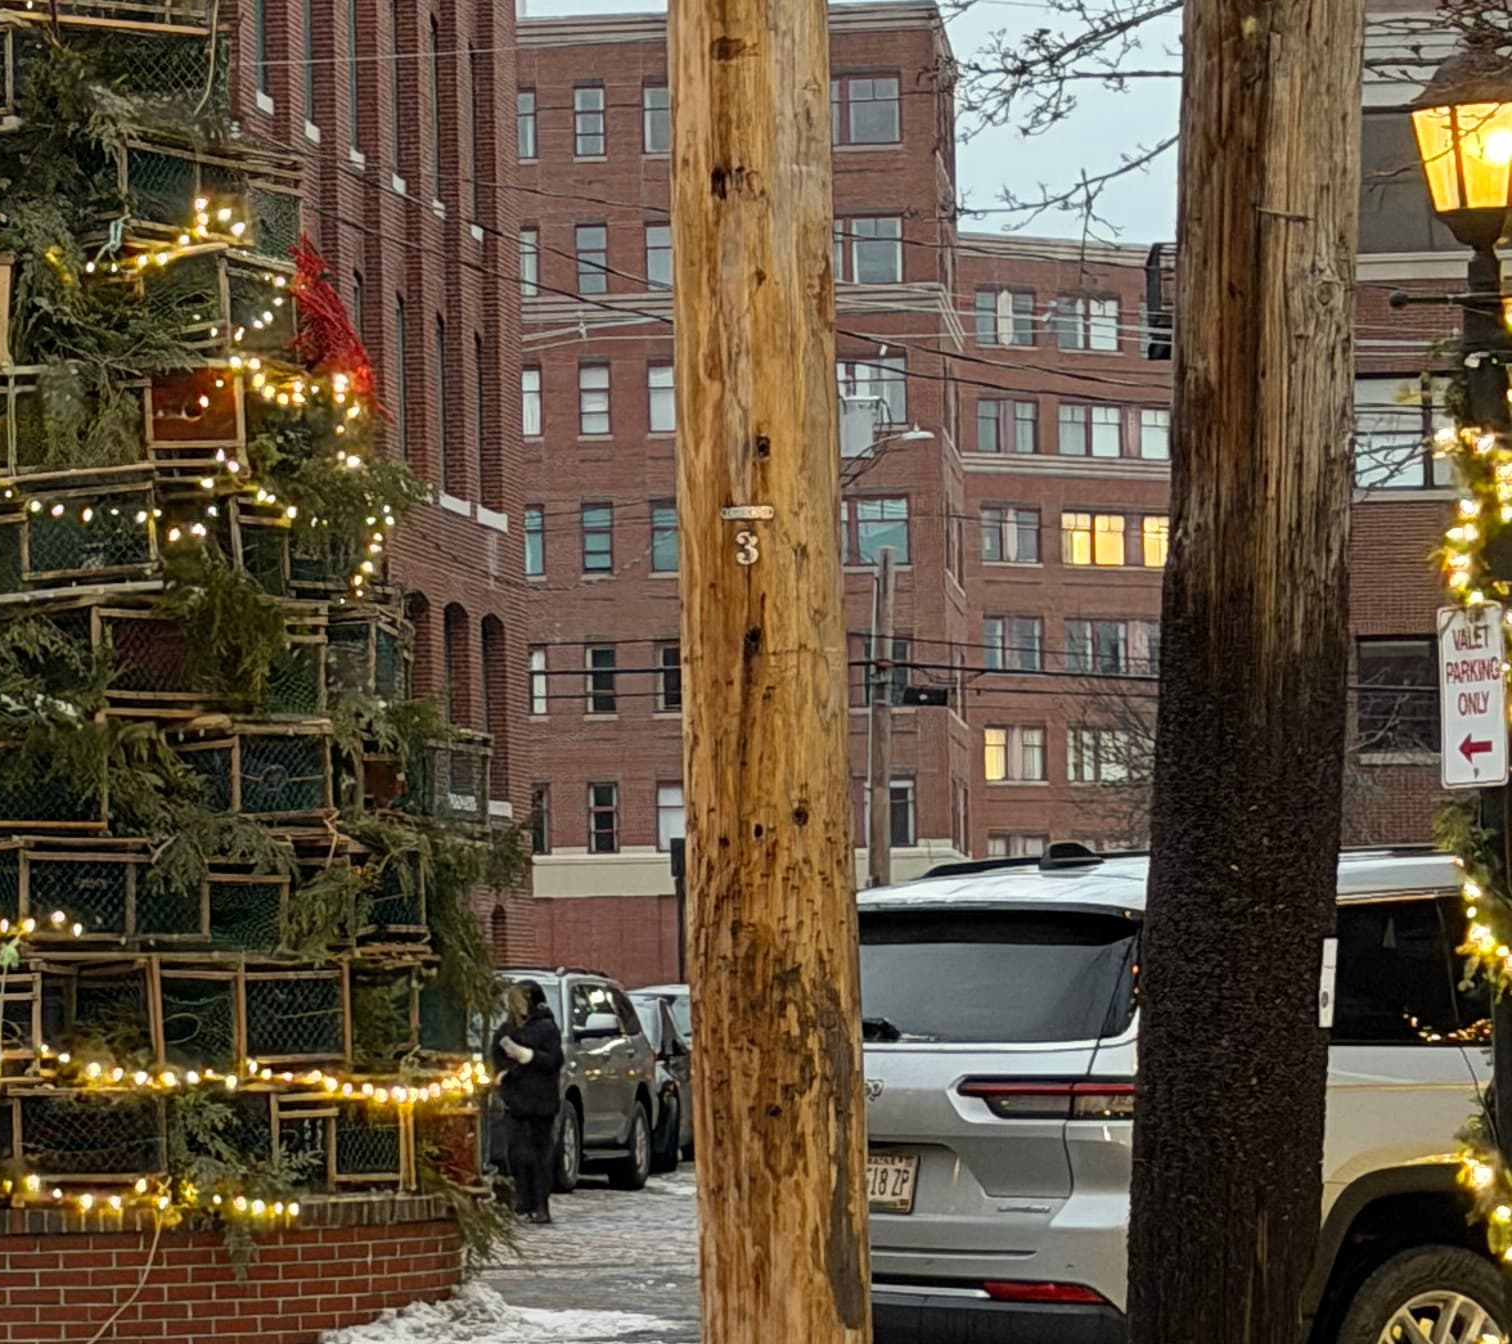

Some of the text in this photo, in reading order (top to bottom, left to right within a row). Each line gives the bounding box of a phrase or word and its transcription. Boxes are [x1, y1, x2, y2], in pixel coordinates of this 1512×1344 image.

[736, 531, 759, 566] 3
[1452, 625, 1490, 651] VALET
[1446, 656, 1500, 685] PARKING
[1457, 690, 1490, 716] ONLY
